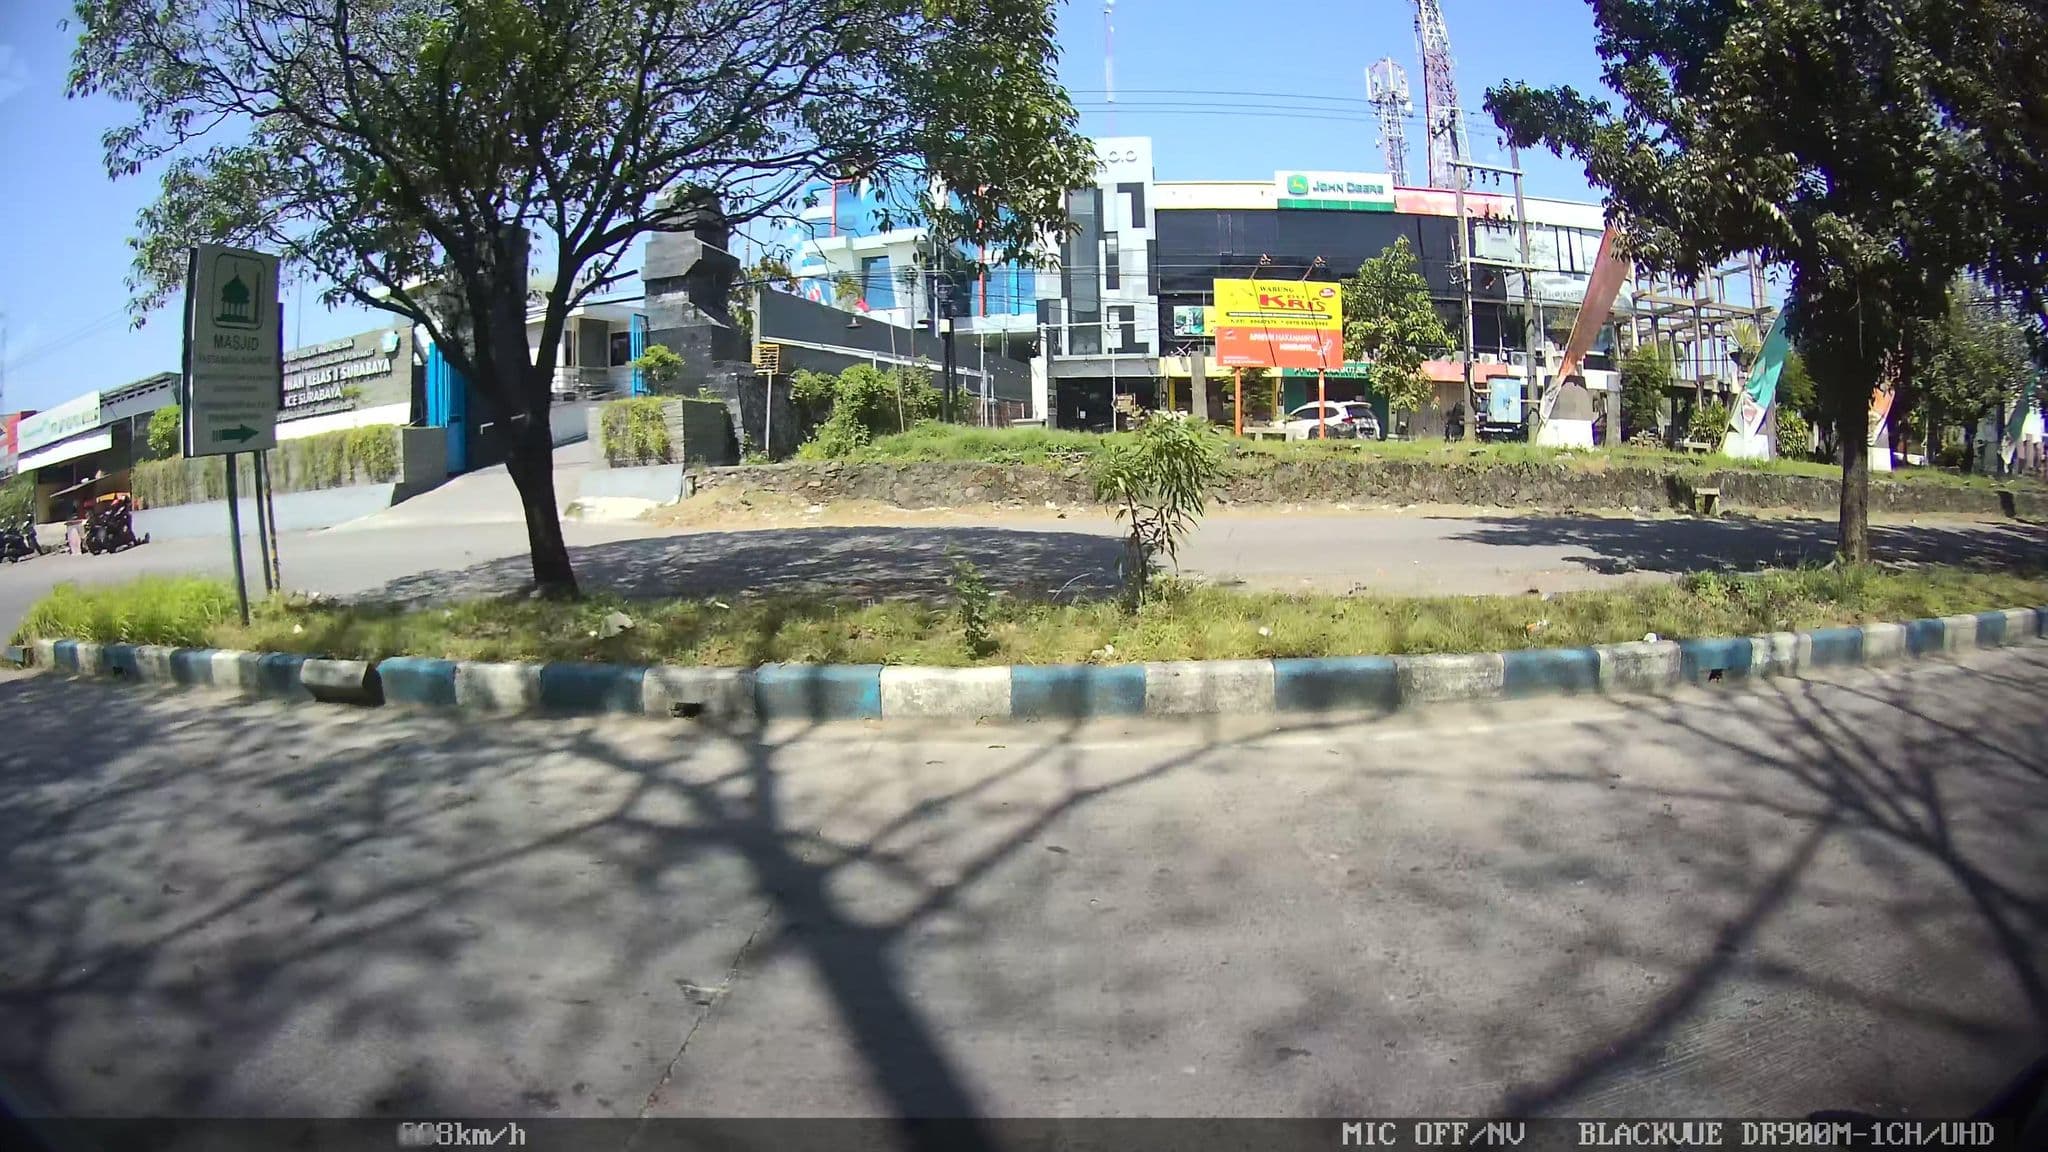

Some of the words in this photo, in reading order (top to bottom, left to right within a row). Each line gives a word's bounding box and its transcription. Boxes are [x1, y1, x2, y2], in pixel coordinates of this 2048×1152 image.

[1313, 181, 1344, 193] JOHN
[1346, 182, 1384, 195] DEERE
[214, 333, 260, 351] MASJID
[306, 368, 332, 387] KELAS
[340, 357, 391, 380] SURABAYA
